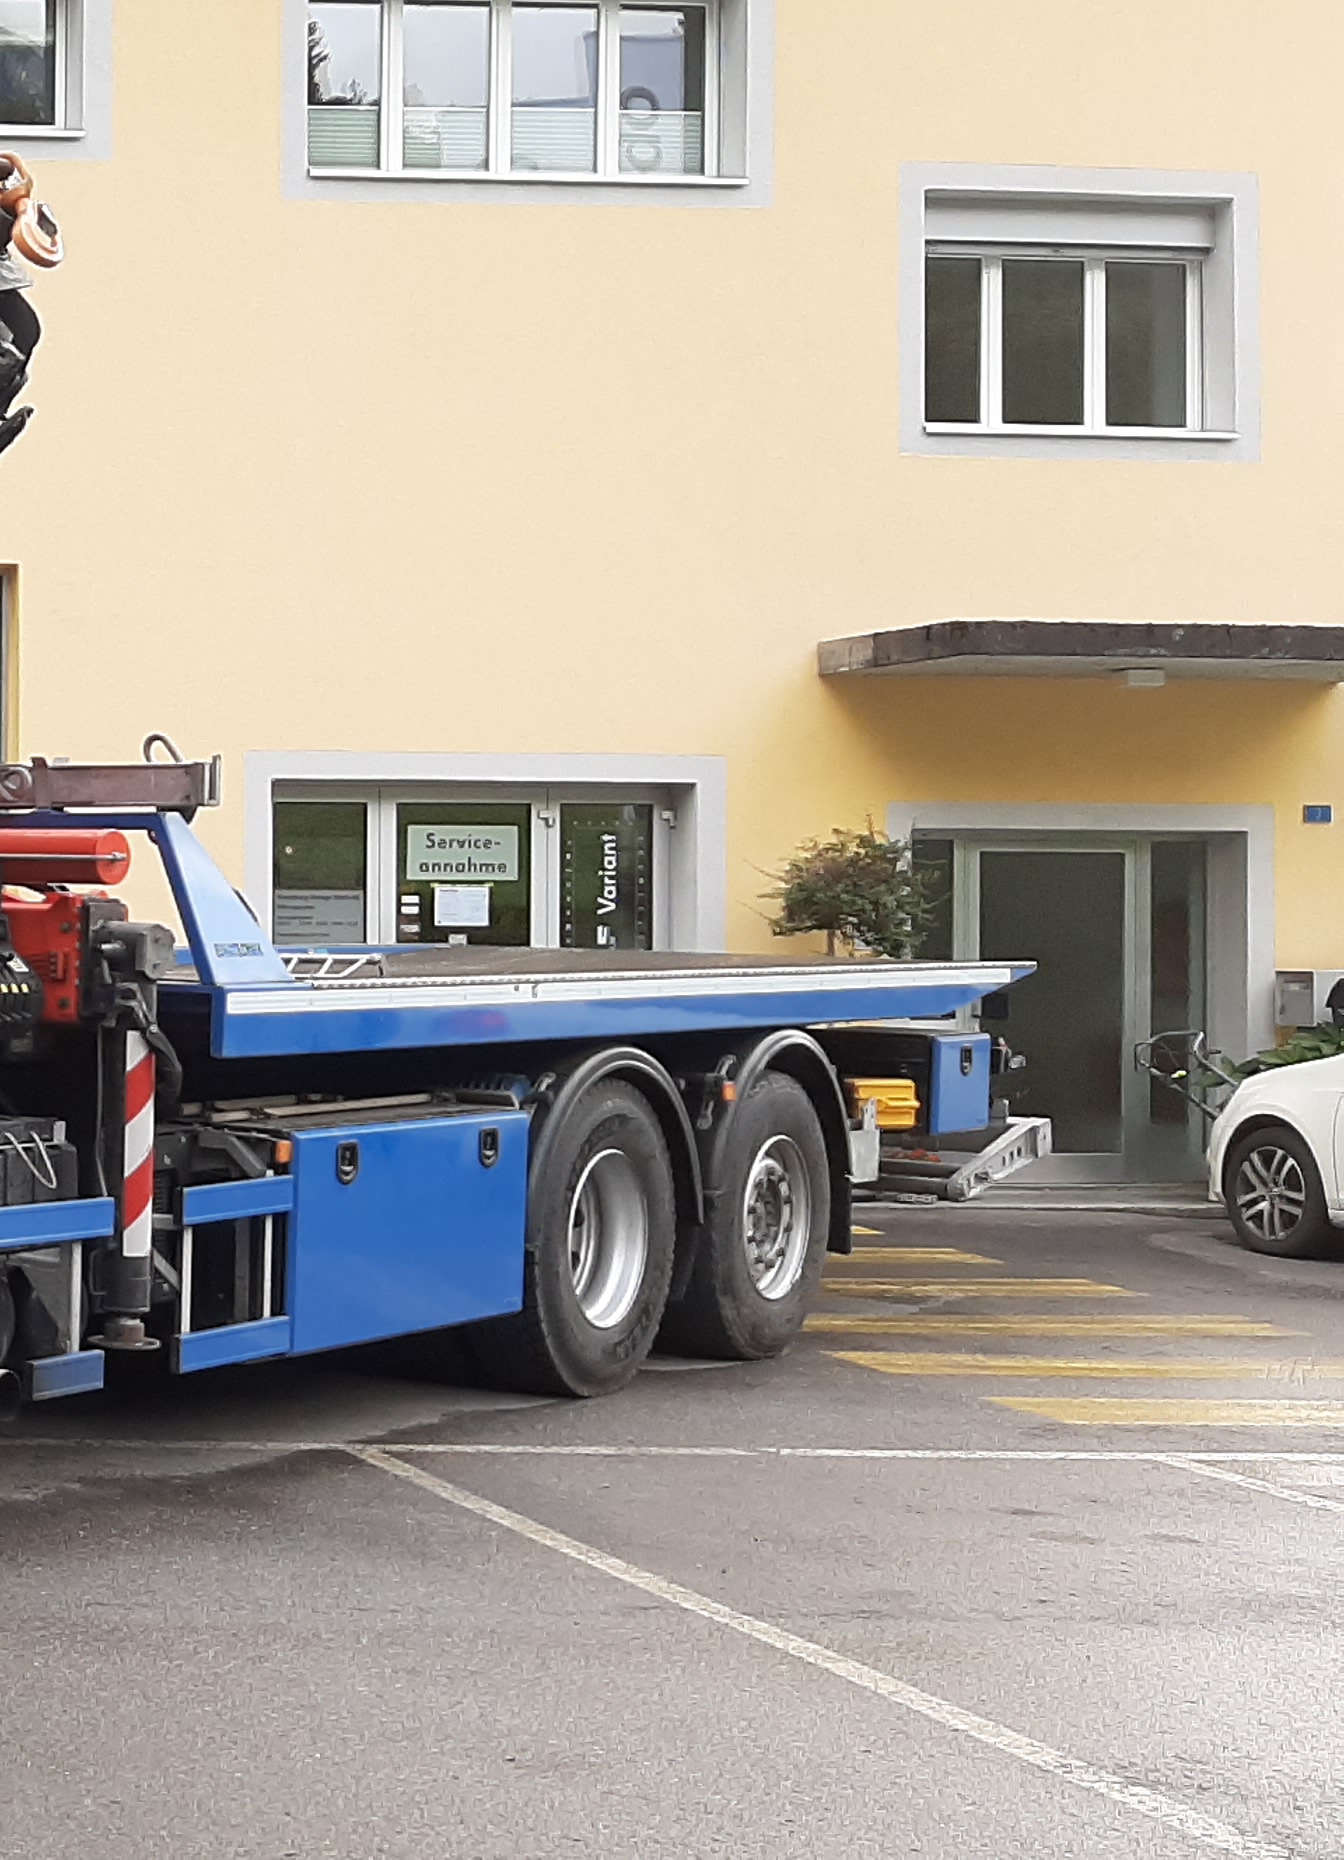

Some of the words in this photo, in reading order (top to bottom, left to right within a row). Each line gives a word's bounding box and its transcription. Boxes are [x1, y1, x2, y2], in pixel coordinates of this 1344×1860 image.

[425, 832, 502, 850] Service-
[418, 856, 508, 874] annahme
[596, 833, 618, 915] Variant
